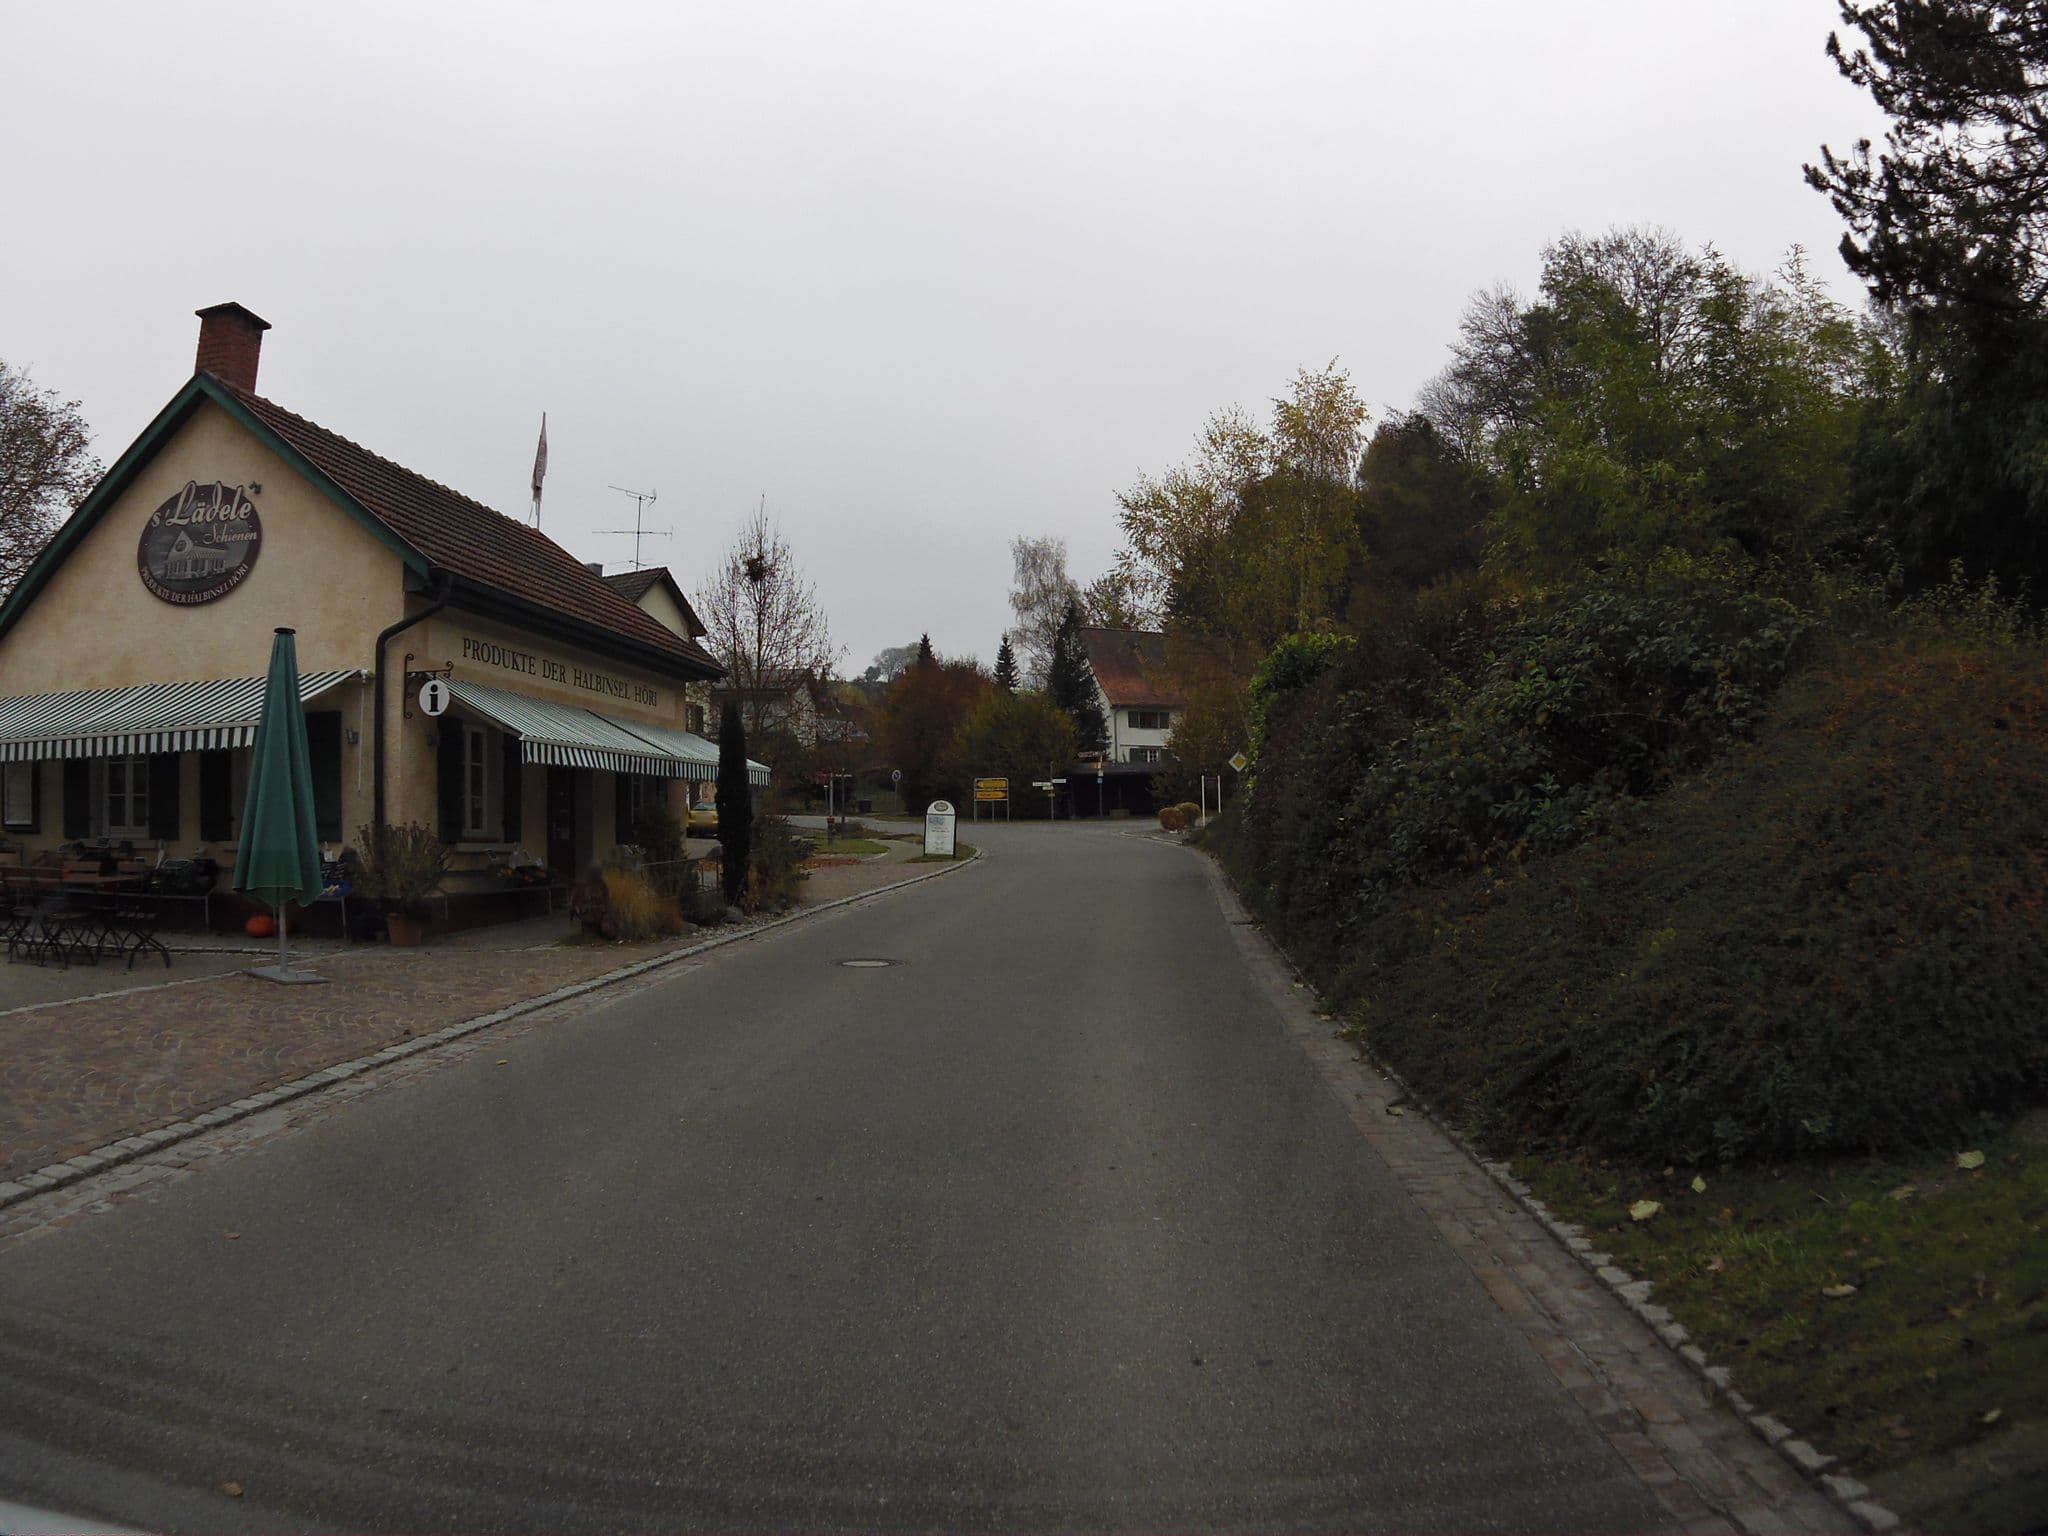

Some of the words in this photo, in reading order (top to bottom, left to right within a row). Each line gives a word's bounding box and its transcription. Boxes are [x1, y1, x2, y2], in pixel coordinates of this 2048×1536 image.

[462, 637, 537, 675] PRODUKTE
[542, 658, 567, 684] DER
[573, 667, 630, 700] HALBINSEL
